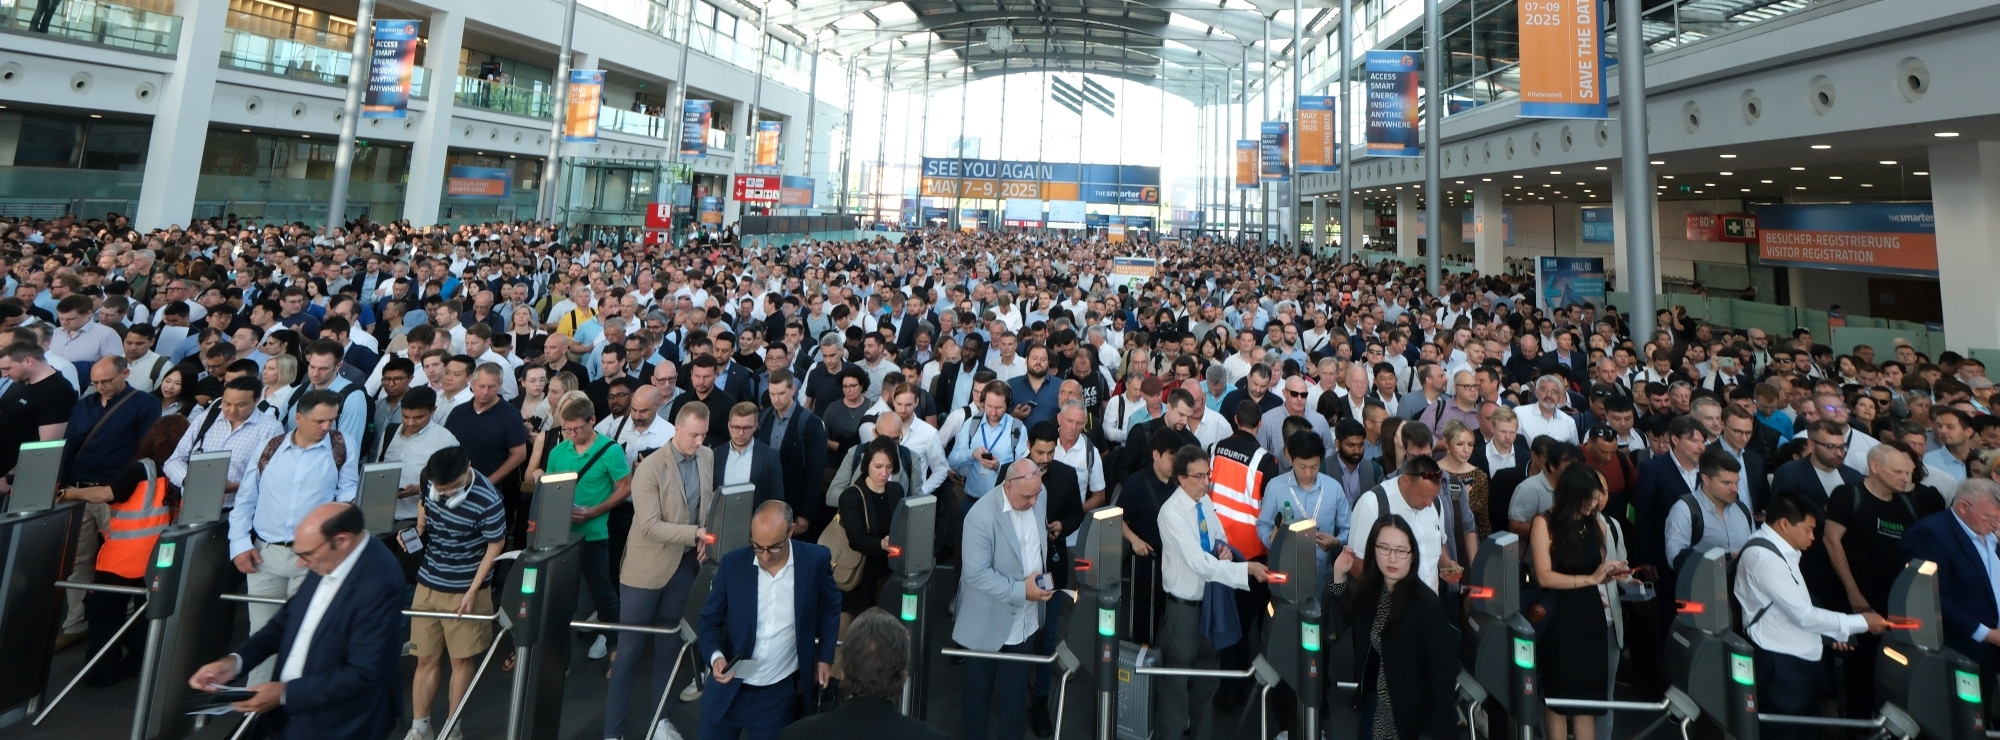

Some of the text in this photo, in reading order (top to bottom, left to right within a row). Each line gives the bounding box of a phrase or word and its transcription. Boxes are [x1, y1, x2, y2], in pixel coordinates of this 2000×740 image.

[1525, 14, 1561, 26] 2025
[1576, 0, 1593, 98] SAVE THE DAT
[928, 160, 1053, 180] SEE YOU AGAIN
[927, 180, 958, 194] MAY
[1001, 183, 1037, 198] 2025
[1766, 232, 1900, 249] BESUCHER-REGISTRIERUNG
[1766, 246, 1874, 263] VISITOR REGISTRATION
[1572, 262, 1584, 271] HALL
[1216, 446, 1250, 462] SECURITY
